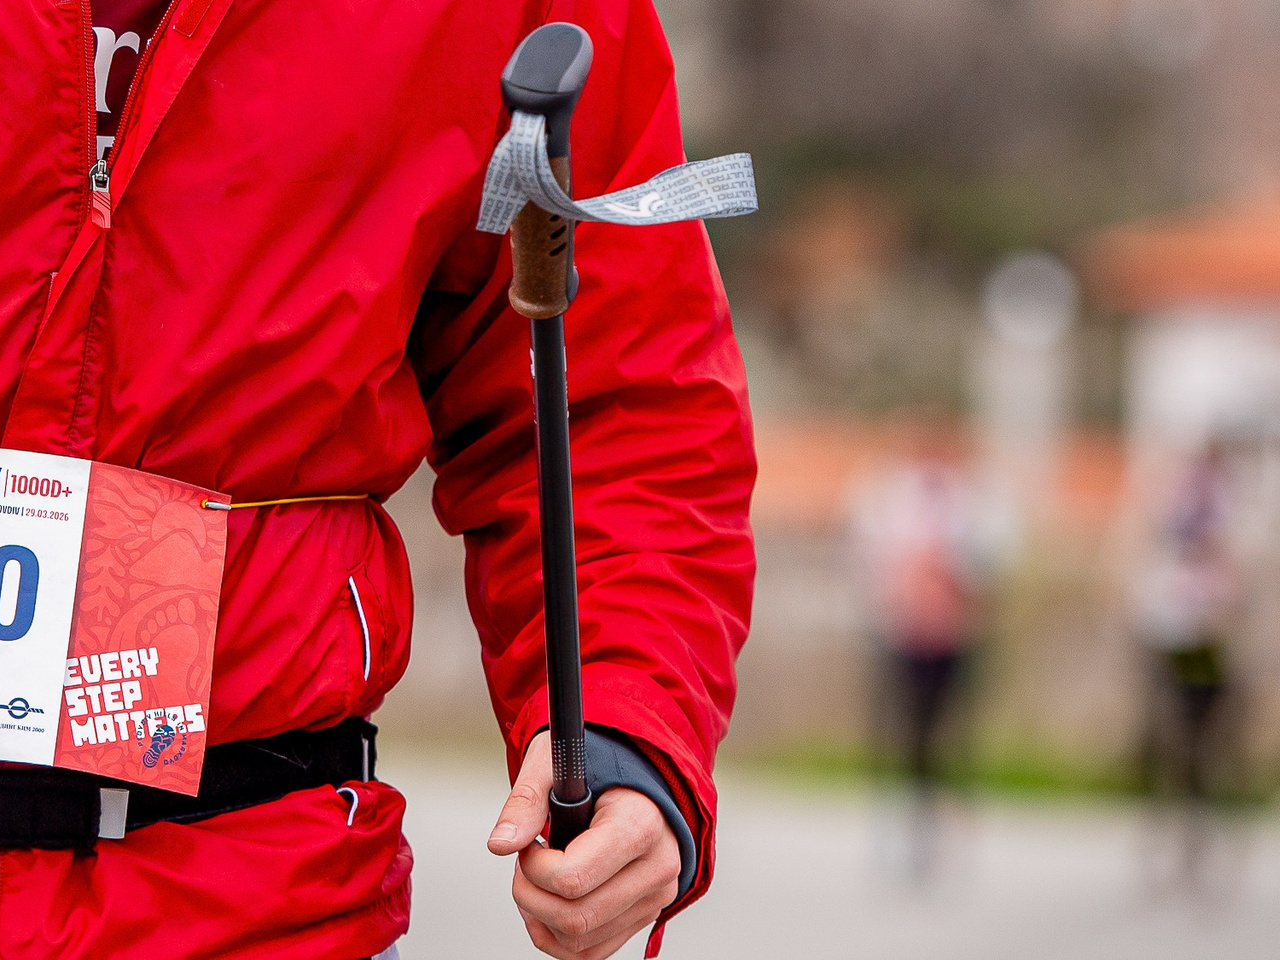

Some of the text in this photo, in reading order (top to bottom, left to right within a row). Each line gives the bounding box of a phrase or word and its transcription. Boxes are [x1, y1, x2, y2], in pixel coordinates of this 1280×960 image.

[11, 474, 73, 499] 1000D+
[25, 508, 70, 522] 29.03.2026
[63, 647, 160, 687] EVERY
[64, 680, 142, 717] STEP
[70, 703, 206, 747] MATTERS
